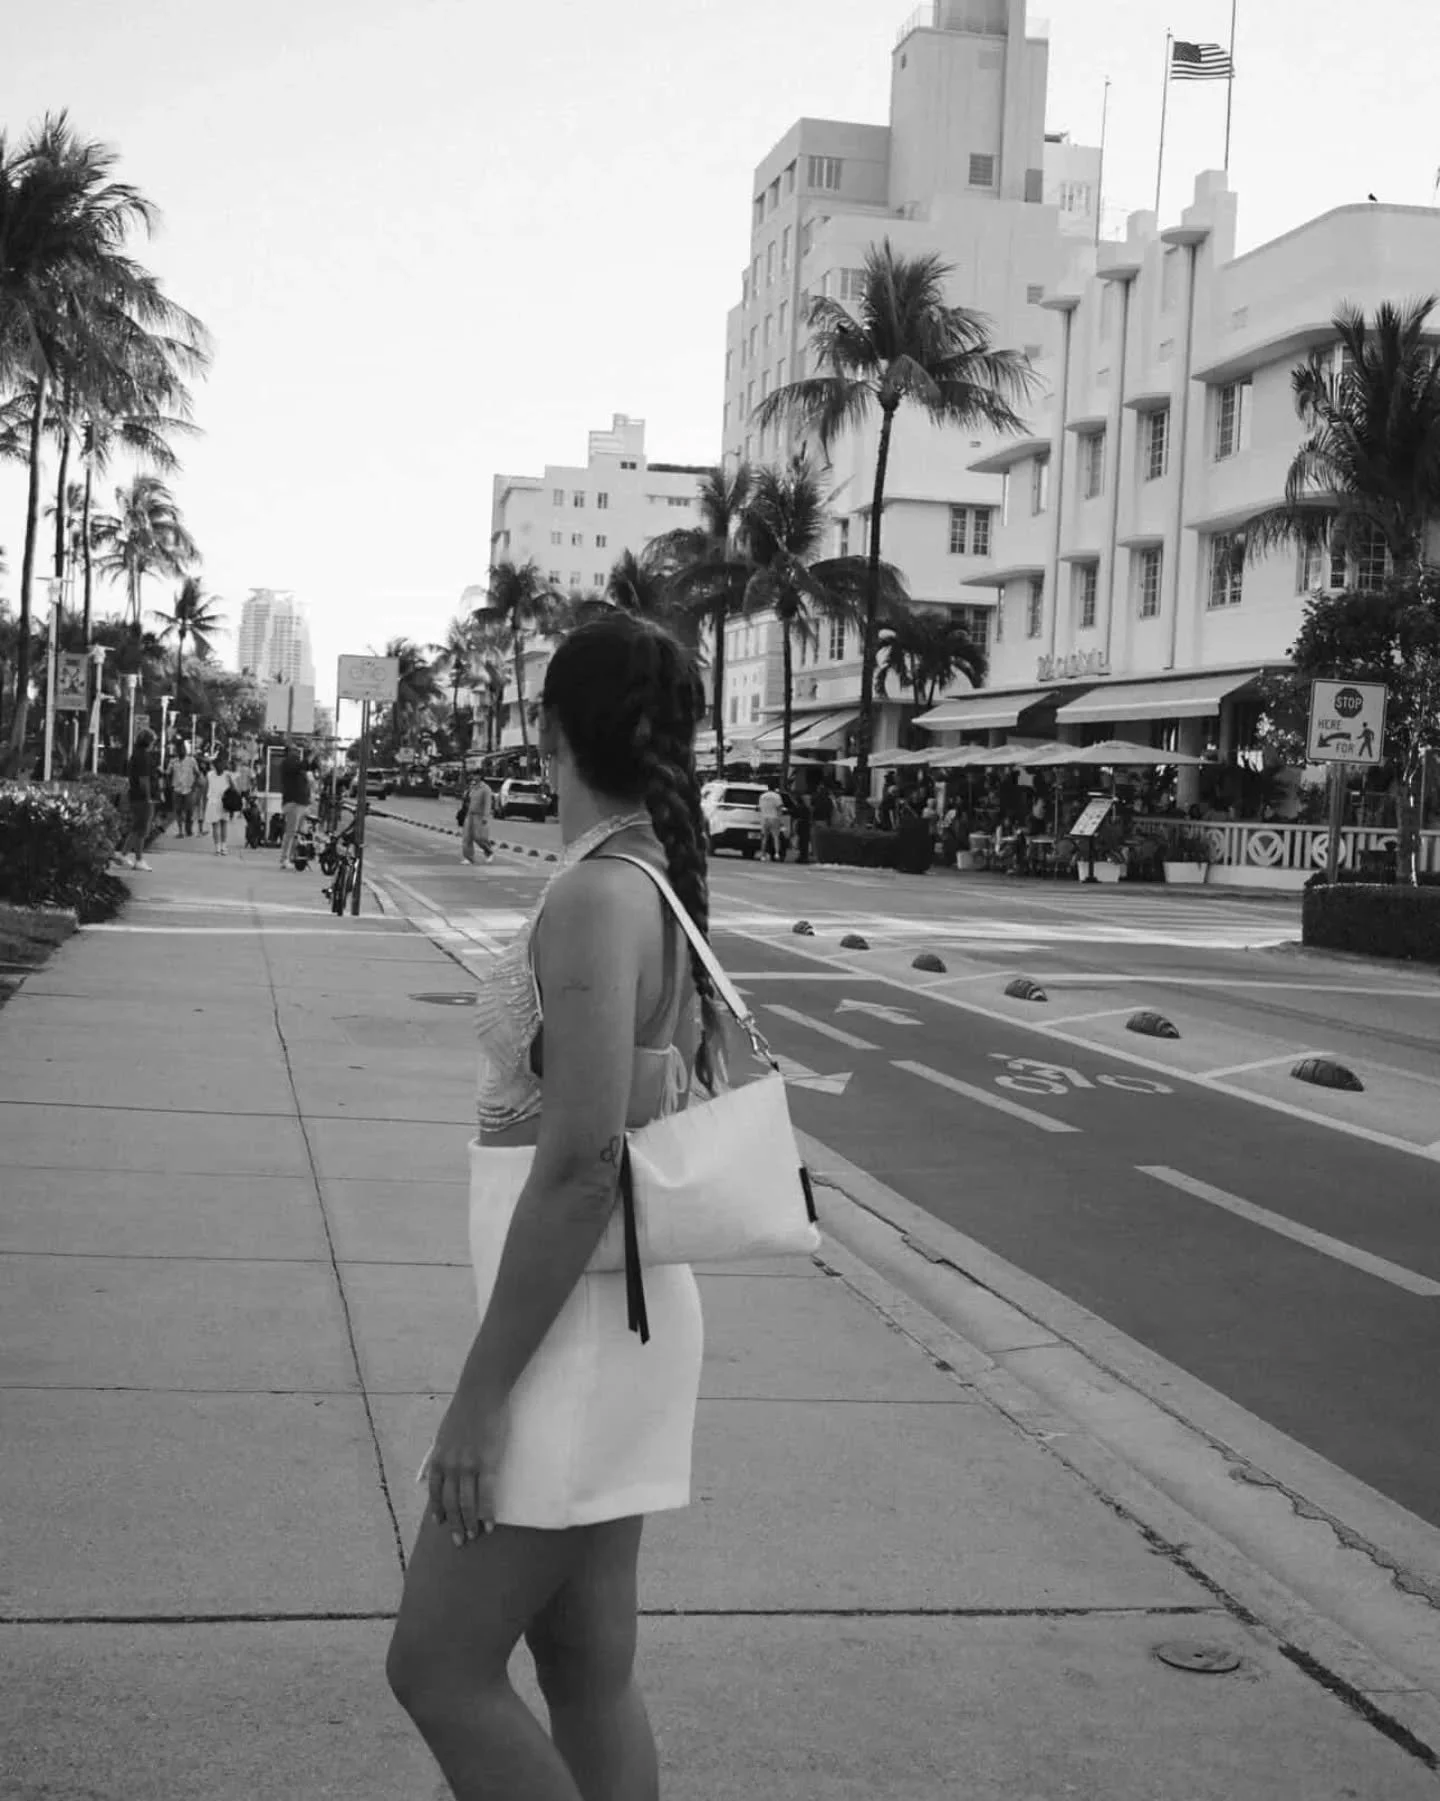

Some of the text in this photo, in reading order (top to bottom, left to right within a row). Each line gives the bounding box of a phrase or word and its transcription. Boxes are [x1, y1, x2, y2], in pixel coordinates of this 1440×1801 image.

[1335, 696, 1363, 709] STOP
[1318, 719, 1343, 730] HERE
[1335, 742, 1355, 754] FOR
